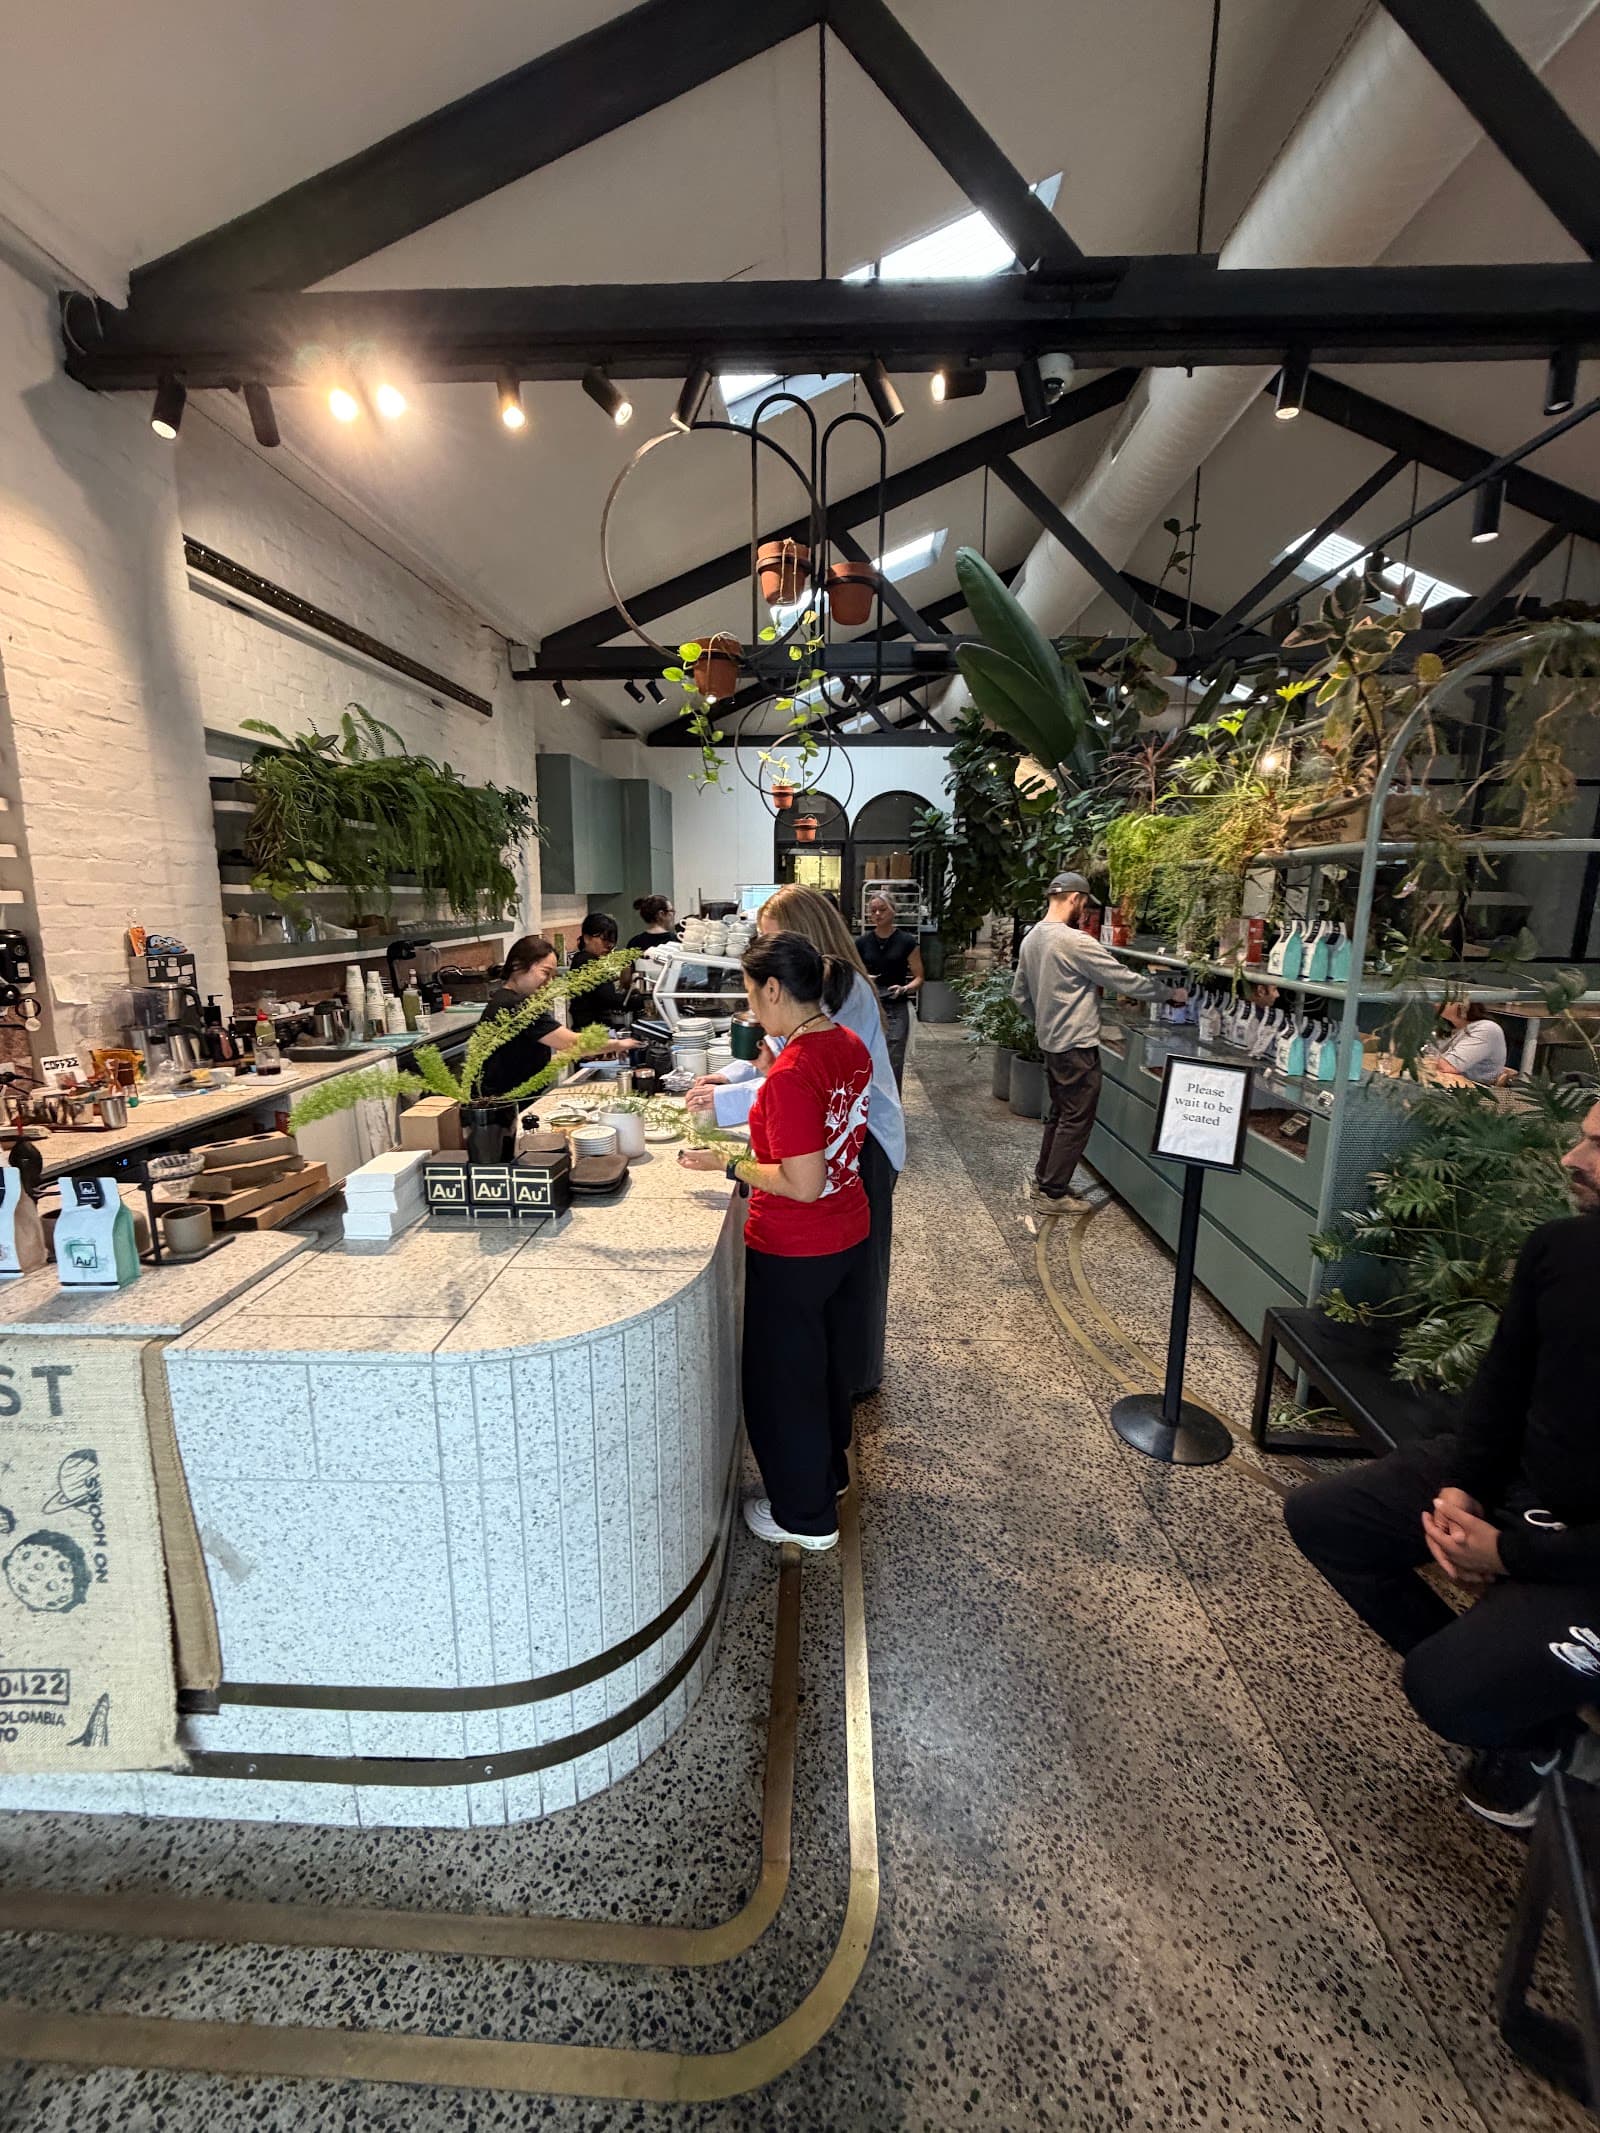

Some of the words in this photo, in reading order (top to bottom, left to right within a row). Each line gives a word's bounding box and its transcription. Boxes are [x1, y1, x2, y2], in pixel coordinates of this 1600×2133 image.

[1187, 1083, 1225, 1098] Please
[1175, 1097, 1200, 1108] wait
[1203, 1101, 1215, 1111] to
[1218, 1102, 1233, 1114] be
[1182, 1113, 1220, 1127] seated
[94, 1553, 108, 1583] NO
